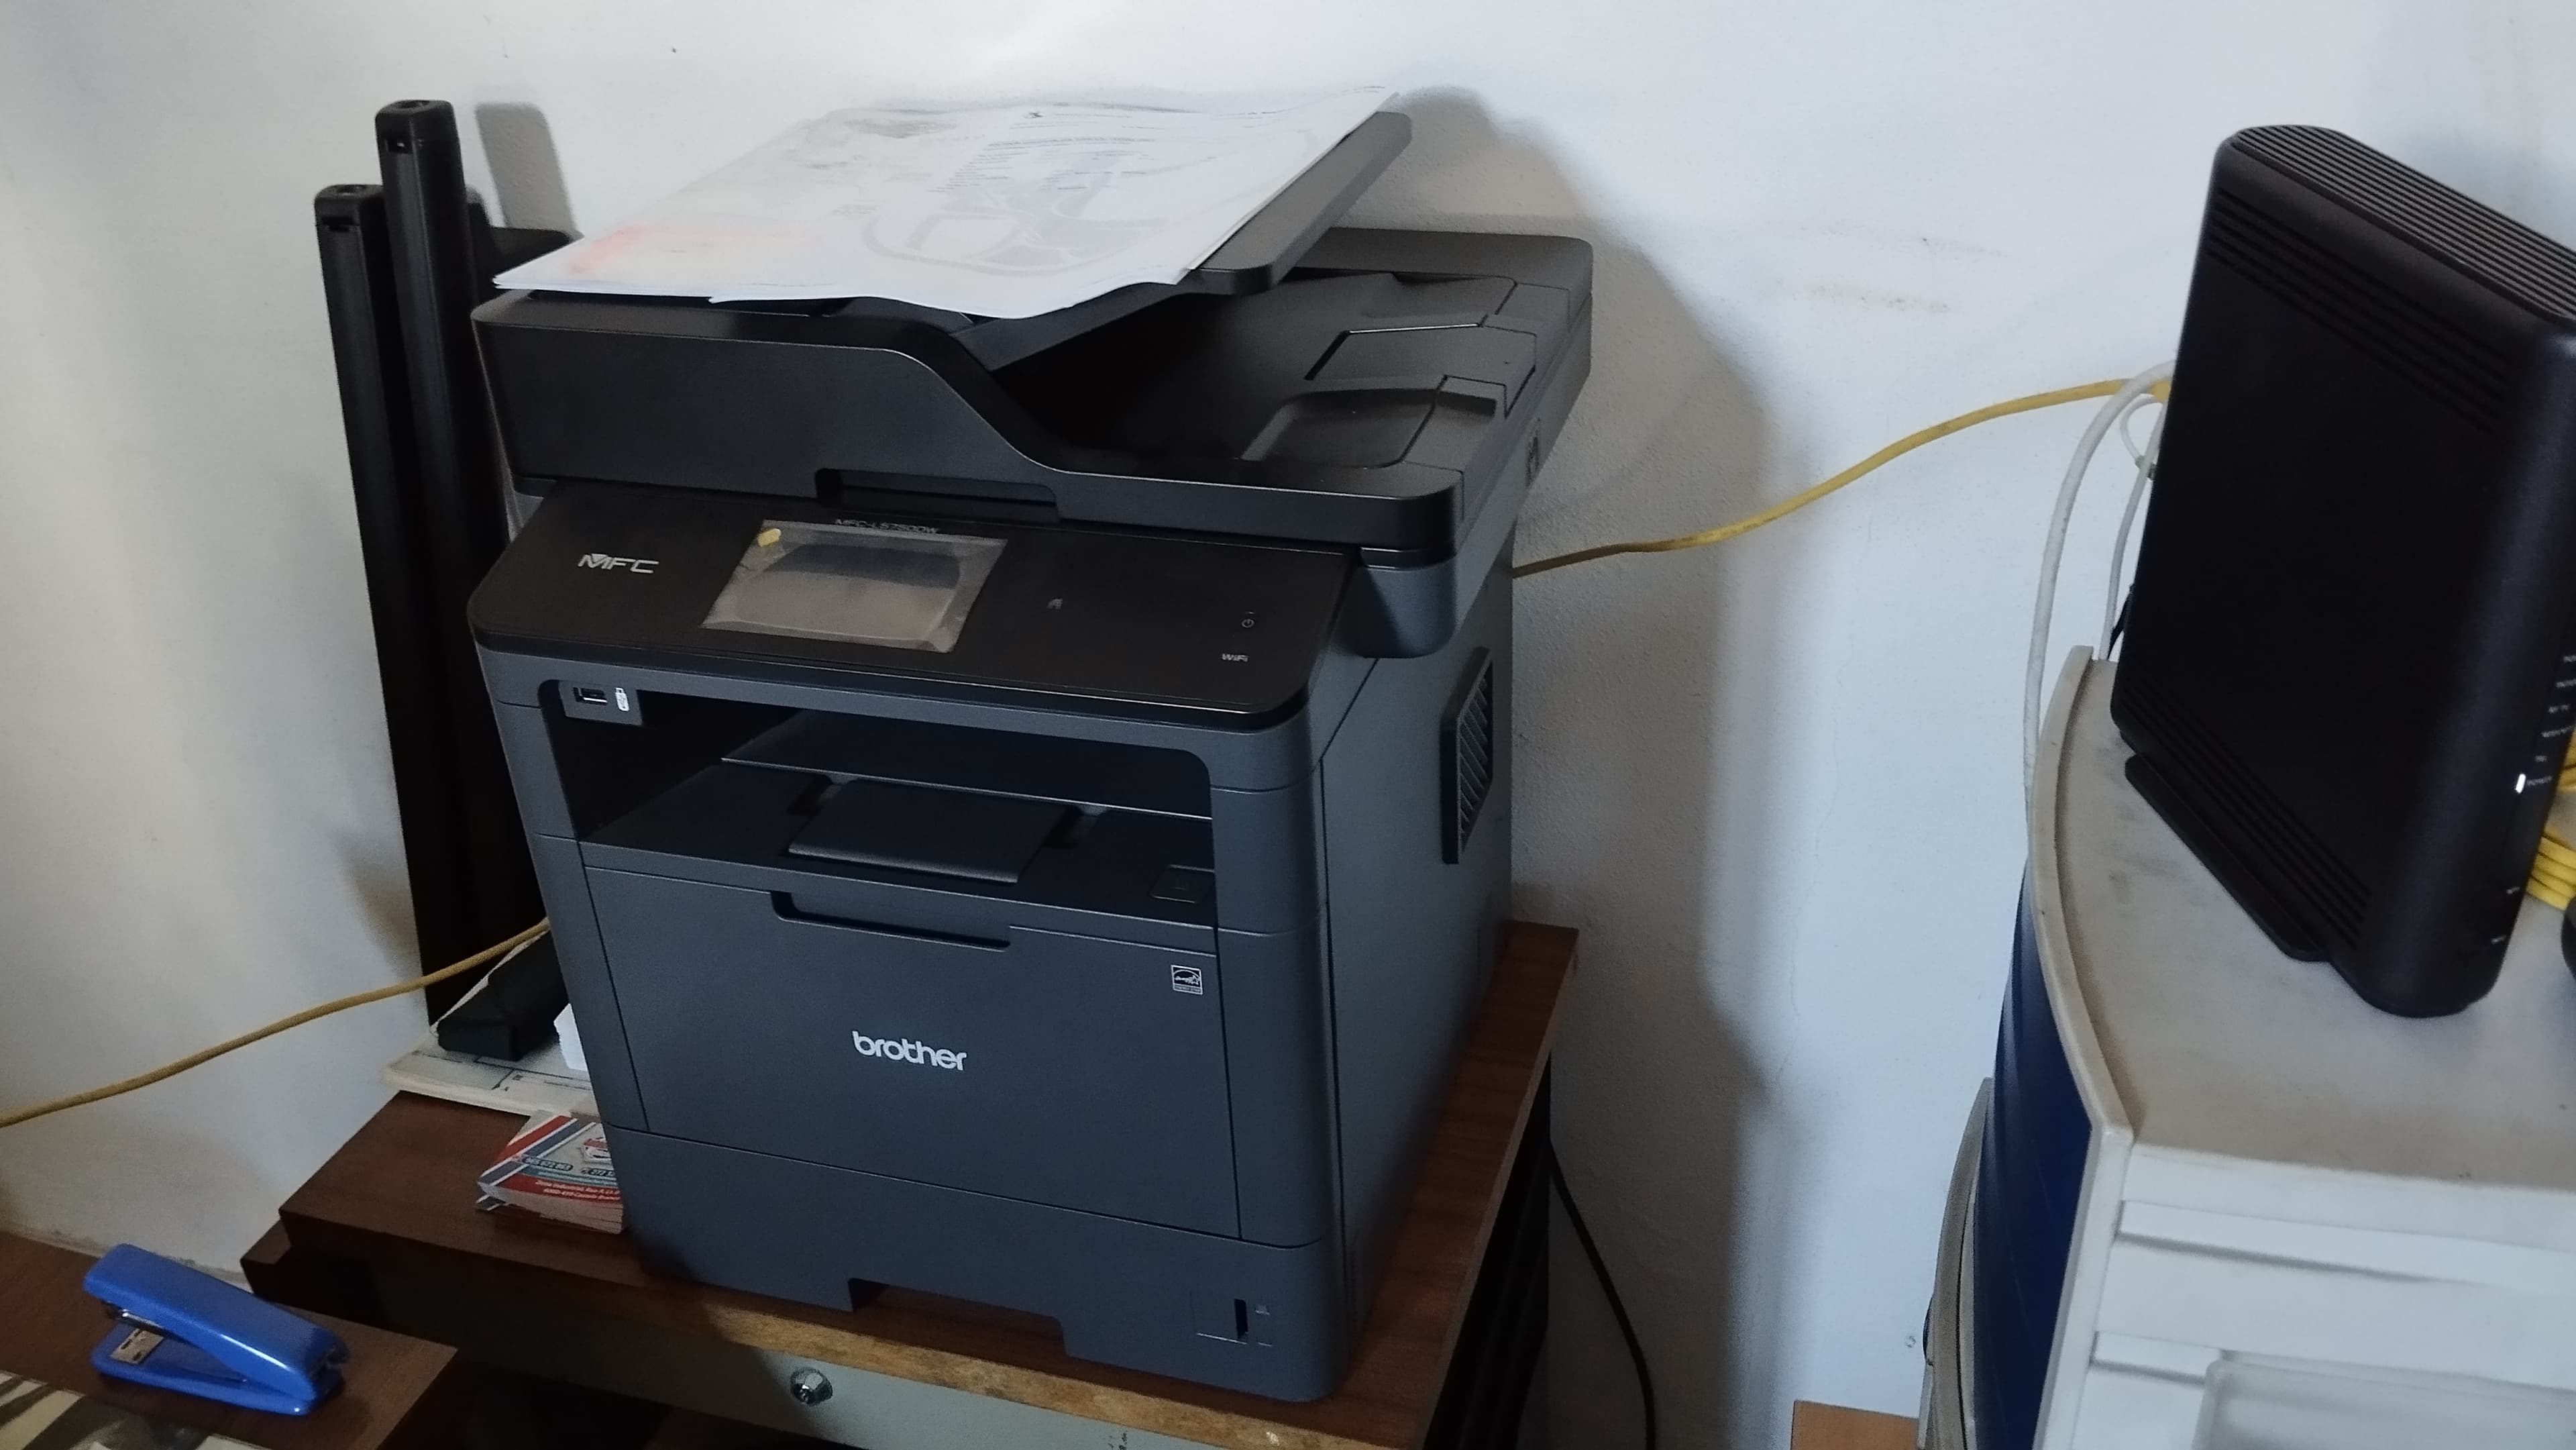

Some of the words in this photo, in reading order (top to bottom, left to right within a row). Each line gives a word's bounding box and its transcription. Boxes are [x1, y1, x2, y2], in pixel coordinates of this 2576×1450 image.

[577, 553, 659, 574] MFC
[1222, 653, 1248, 662] WiFi
[852, 1031, 967, 1071] brother
